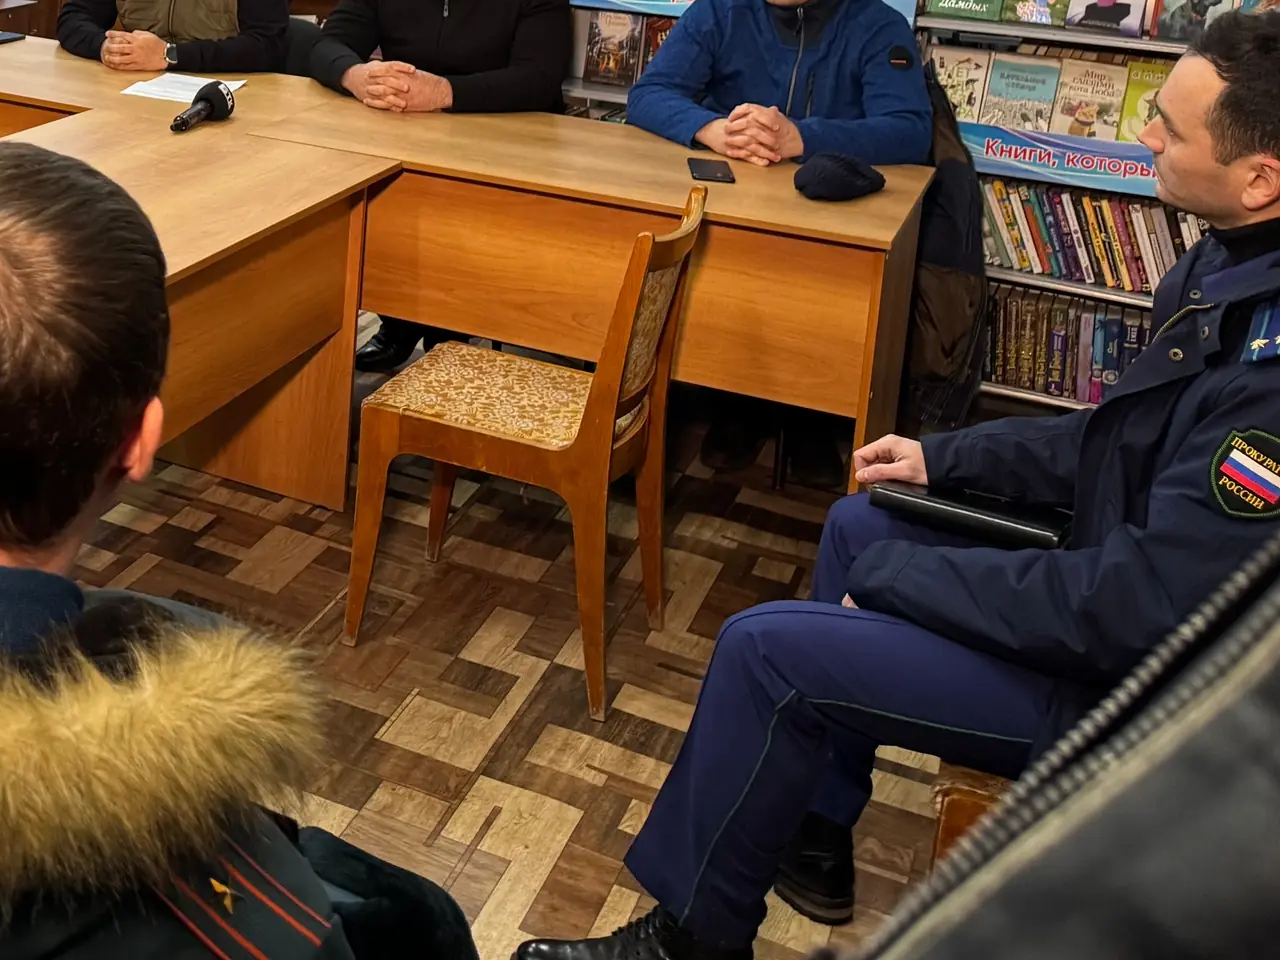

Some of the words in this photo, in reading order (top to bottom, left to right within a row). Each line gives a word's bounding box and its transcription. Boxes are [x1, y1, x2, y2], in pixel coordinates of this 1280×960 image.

[1084, 68, 1106, 81] Мир
[1072, 76, 1116, 90] глазами
[1070, 84, 1088, 94] кота
[1090, 86, 1115, 98] Боба
[984, 137, 1059, 168] Книги,
[1218, 475, 1266, 510] РОССИИ
